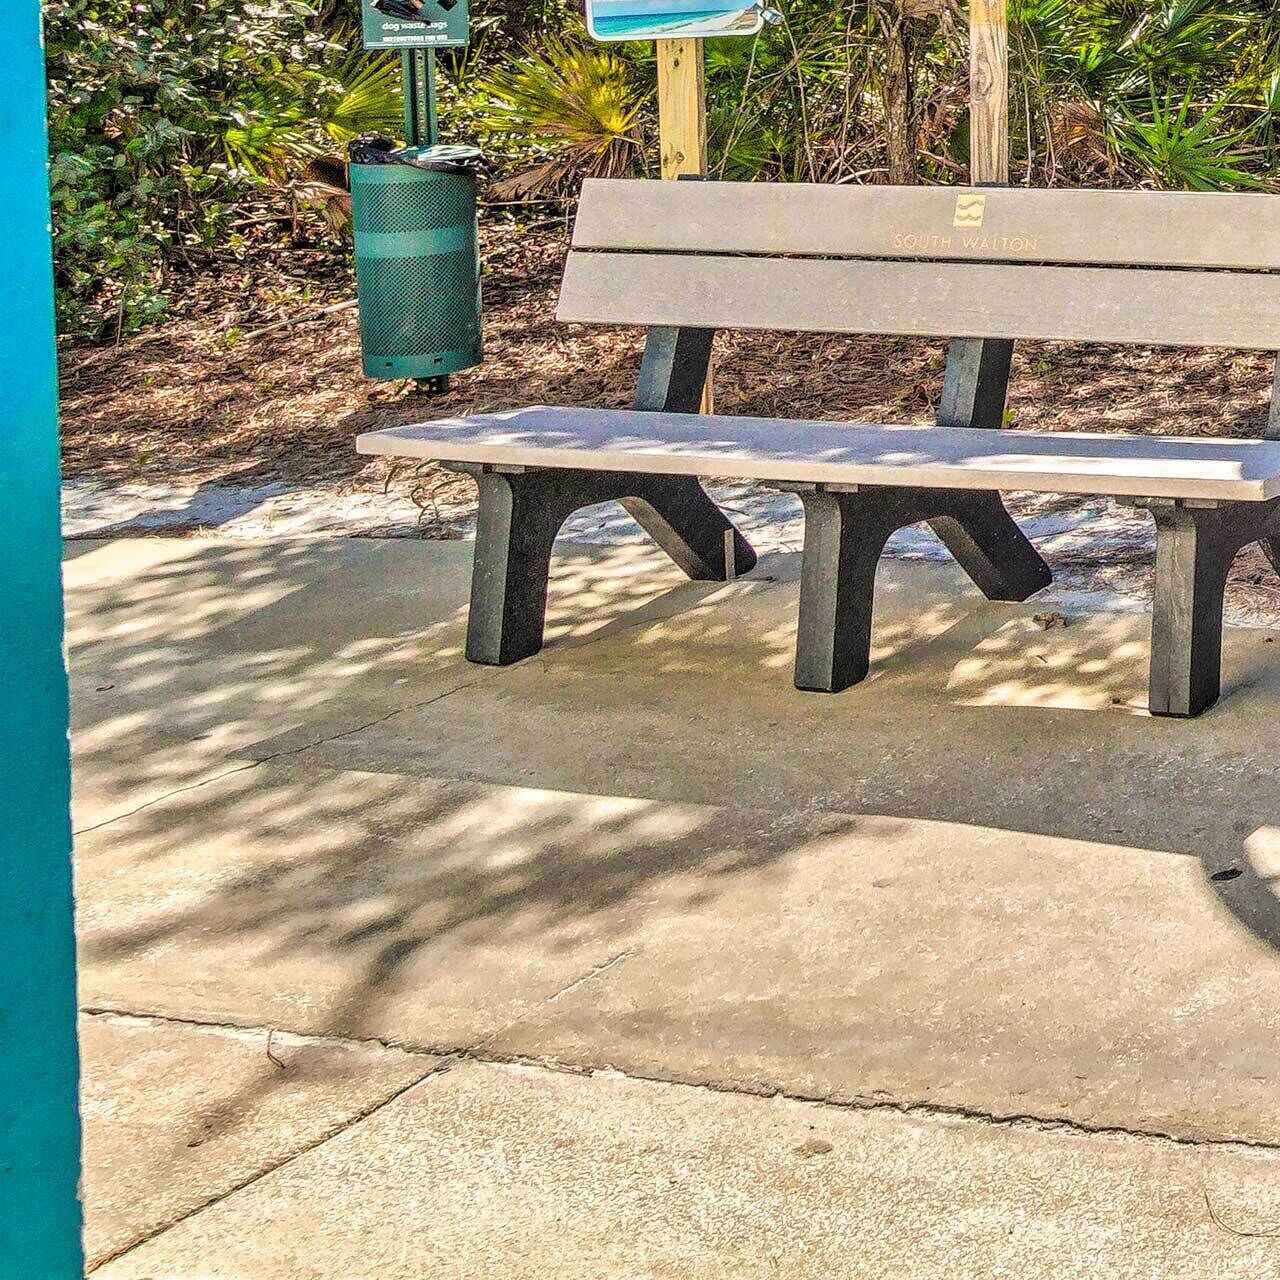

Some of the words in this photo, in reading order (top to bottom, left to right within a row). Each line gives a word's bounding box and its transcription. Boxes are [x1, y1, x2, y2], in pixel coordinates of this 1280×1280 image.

[382, 22, 400, 32] dog
[893, 234, 951, 249] SOUTH
[963, 235, 1038, 252] WALTON
